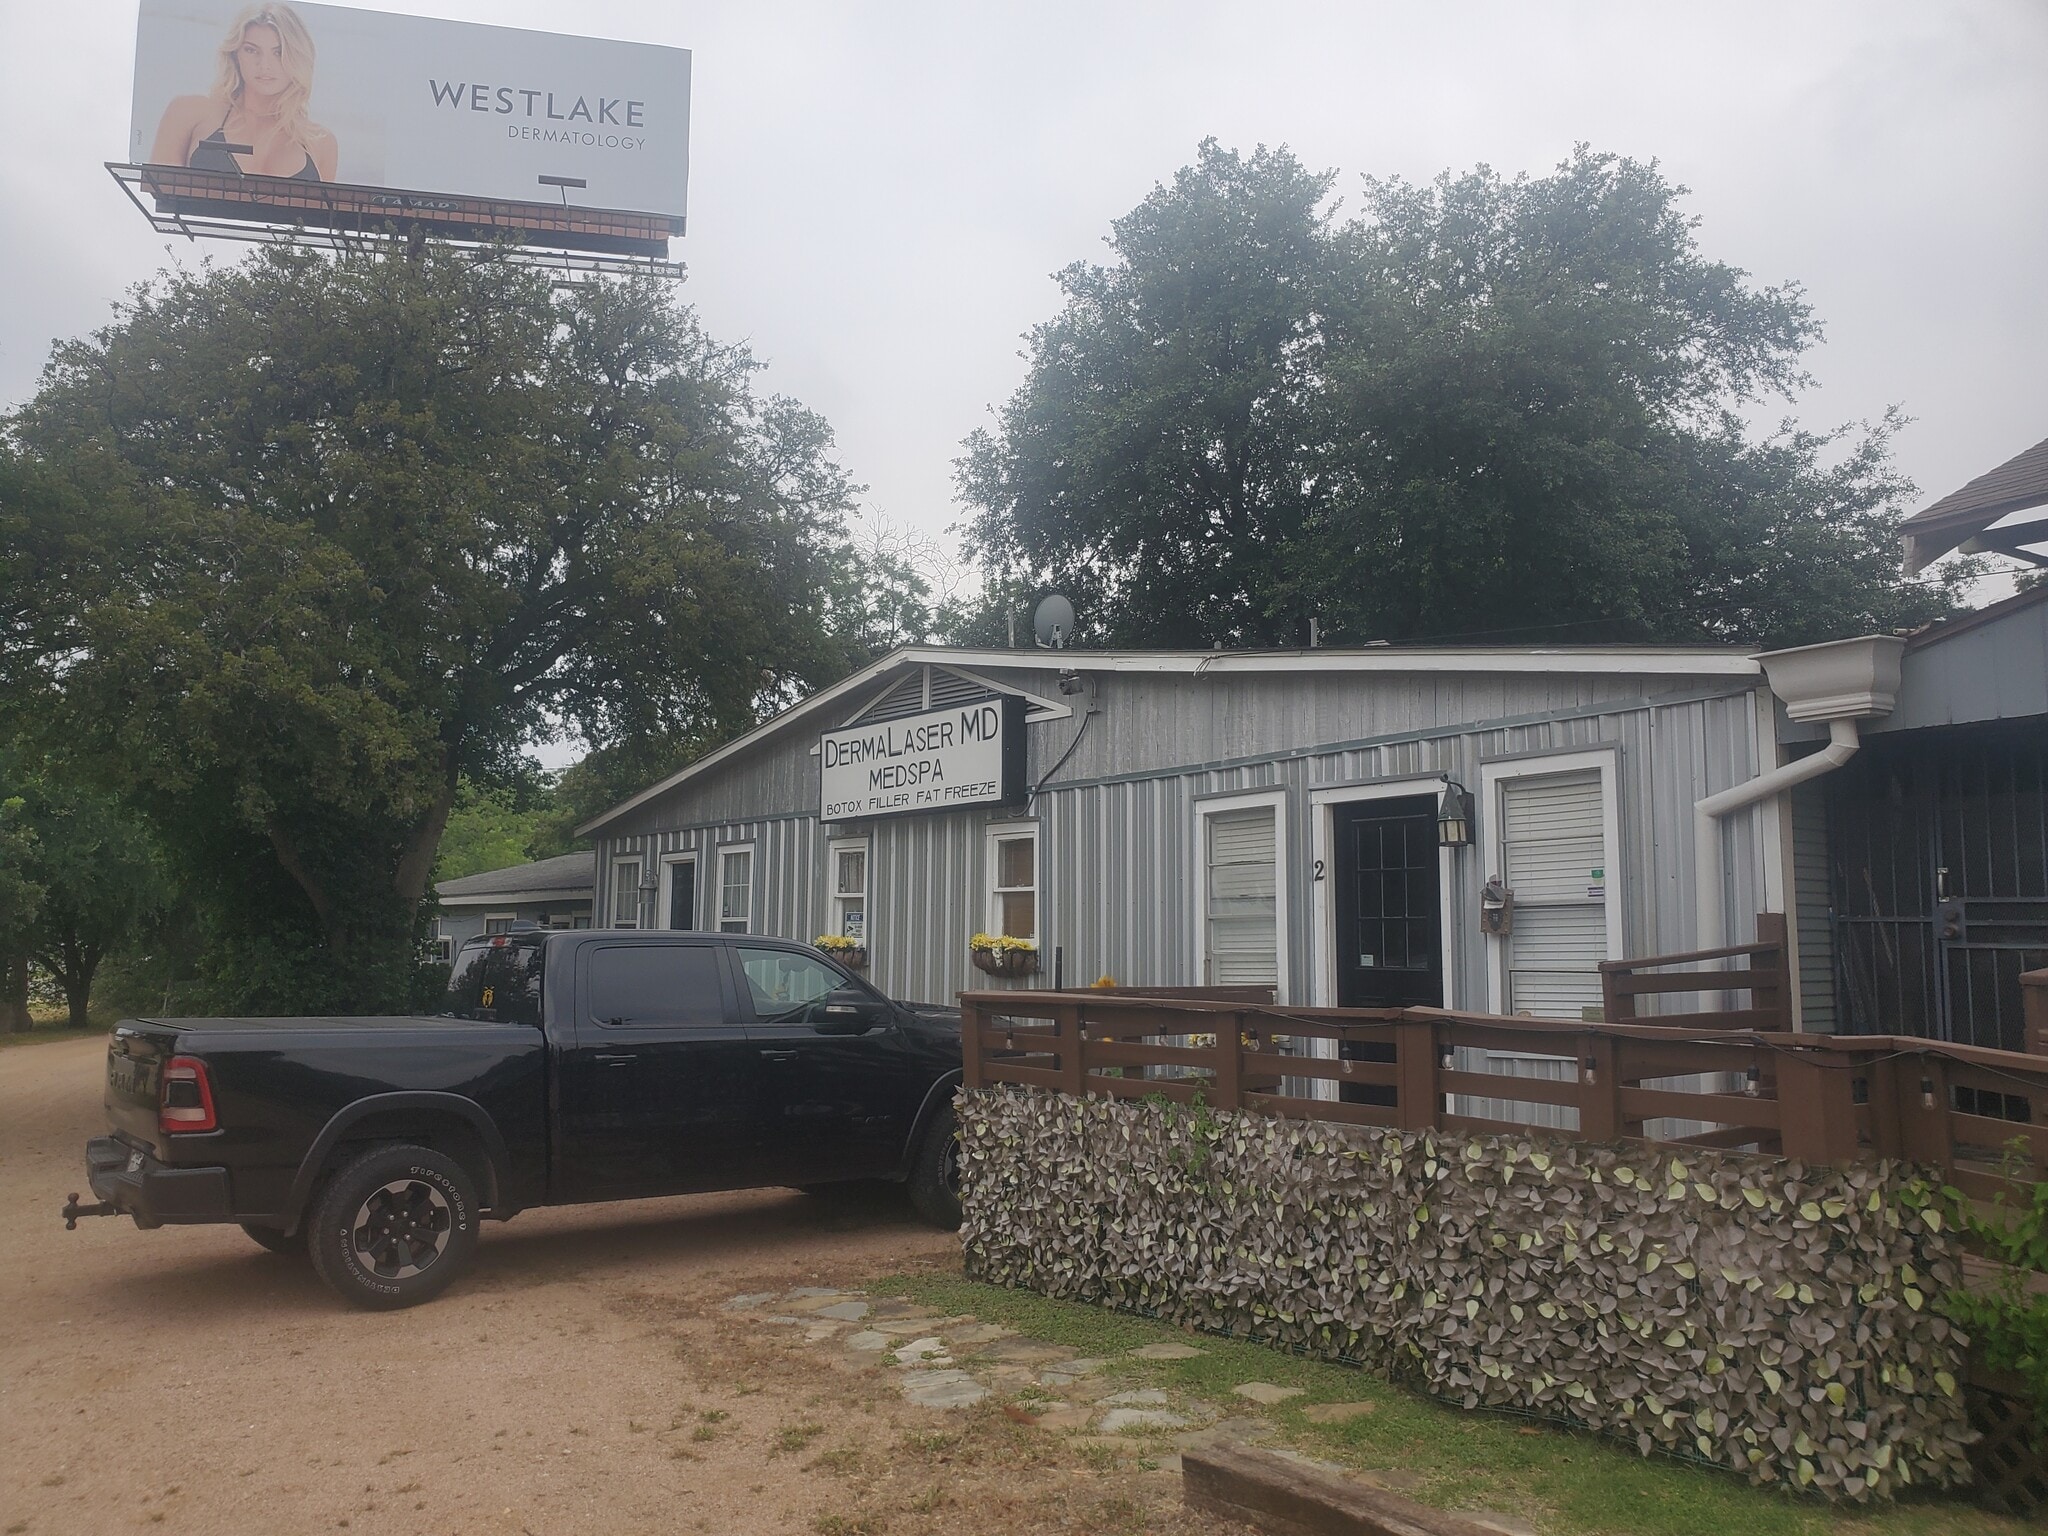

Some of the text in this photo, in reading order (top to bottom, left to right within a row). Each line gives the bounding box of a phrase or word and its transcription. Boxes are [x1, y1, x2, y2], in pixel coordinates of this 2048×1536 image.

[428, 79, 645, 128] WESTLAKE
[508, 125, 646, 151] DERMATOLOGY
[961, 706, 999, 744] MD
[869, 758, 944, 791] MEDSPA
[826, 780, 997, 815] BOTOX FILLER FAT FREEZE
[1313, 860, 1325, 882] 2
[340, 1238, 400, 1294] DESTINATION
